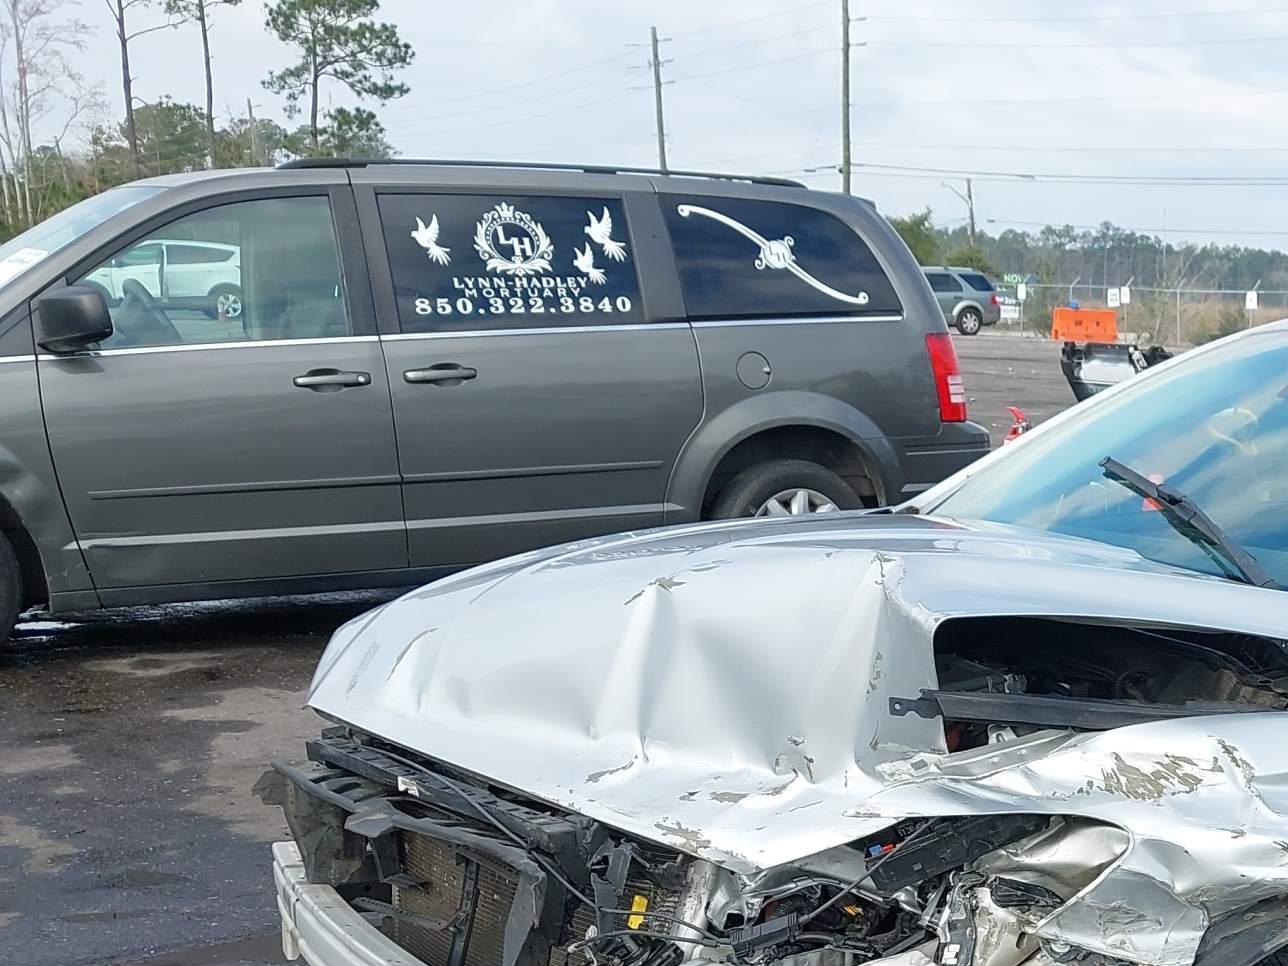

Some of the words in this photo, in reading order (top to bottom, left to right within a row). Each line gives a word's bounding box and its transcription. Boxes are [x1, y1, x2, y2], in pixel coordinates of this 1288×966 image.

[452, 276, 588, 289] LYNN-HADLEY
[464, 287, 581, 298] MORTUARY
[415, 295, 632, 315] 850.322.3840
